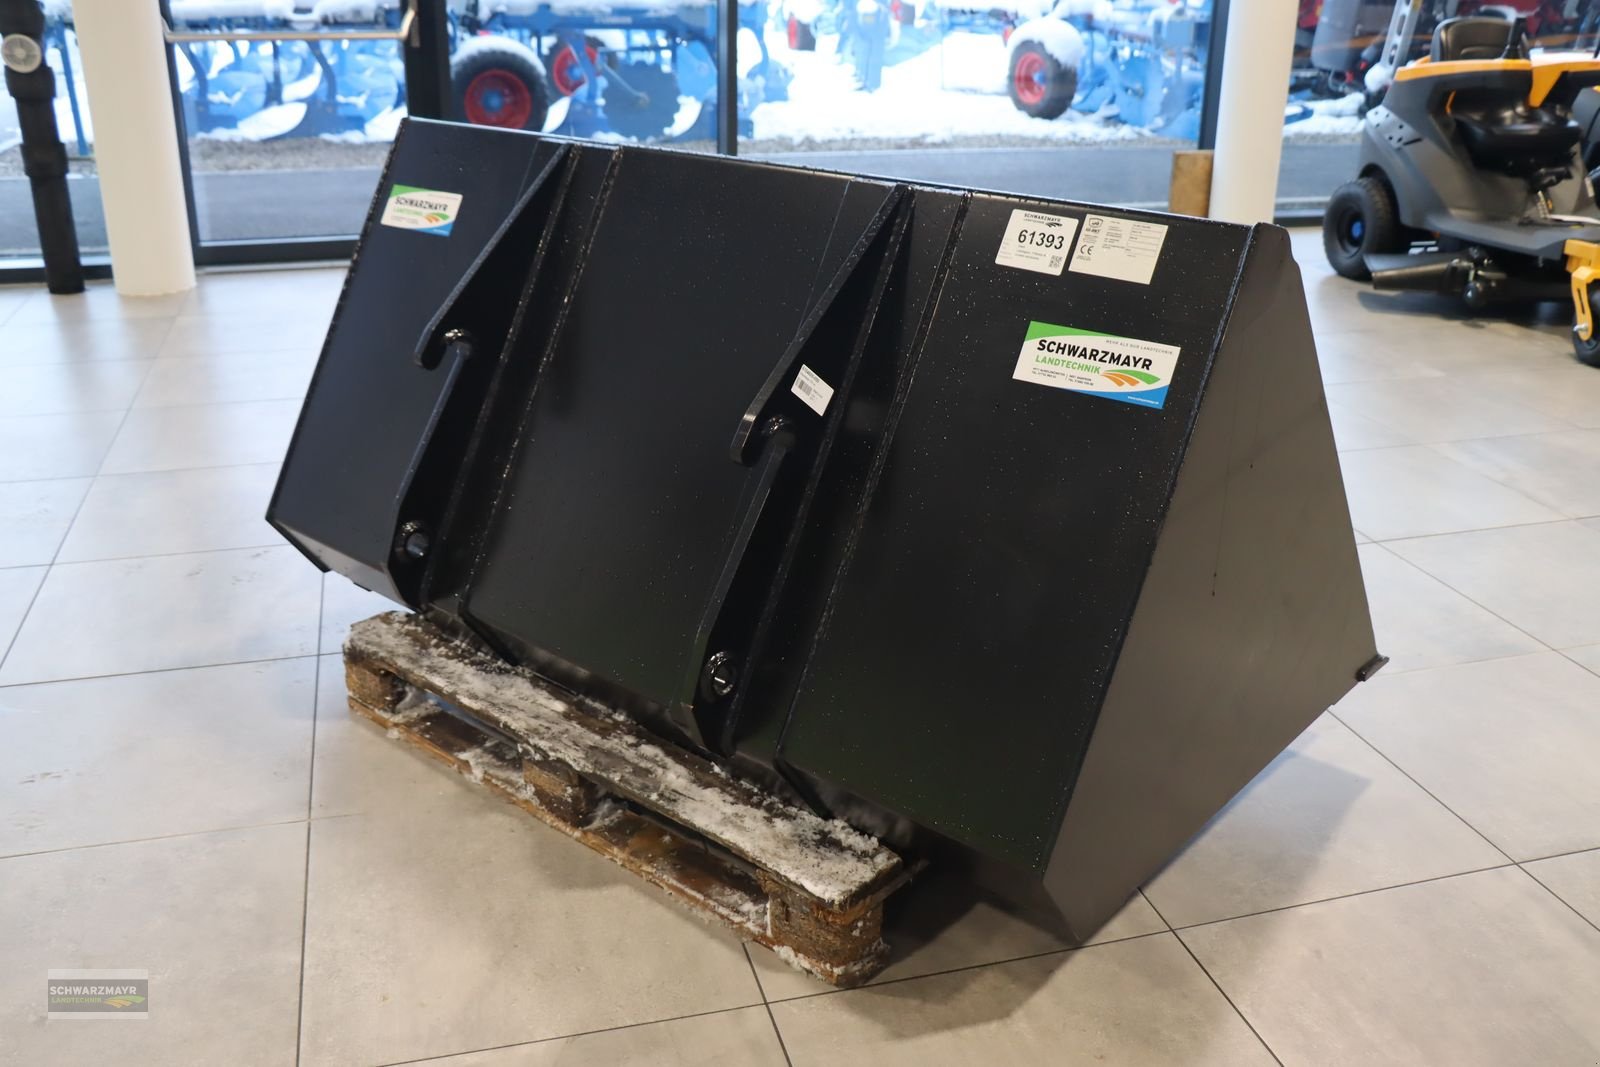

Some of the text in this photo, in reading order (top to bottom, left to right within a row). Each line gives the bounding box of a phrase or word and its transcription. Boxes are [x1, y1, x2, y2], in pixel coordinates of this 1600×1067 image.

[395, 196, 449, 212] SCHWARZMAYR
[1024, 213, 1062, 223] SCHWARZMAYR
[1018, 229, 1065, 250] 61393
[1035, 355, 1101, 375] LANDTECHNIK
[1037, 339, 1153, 371] SCHWARZMAYR
